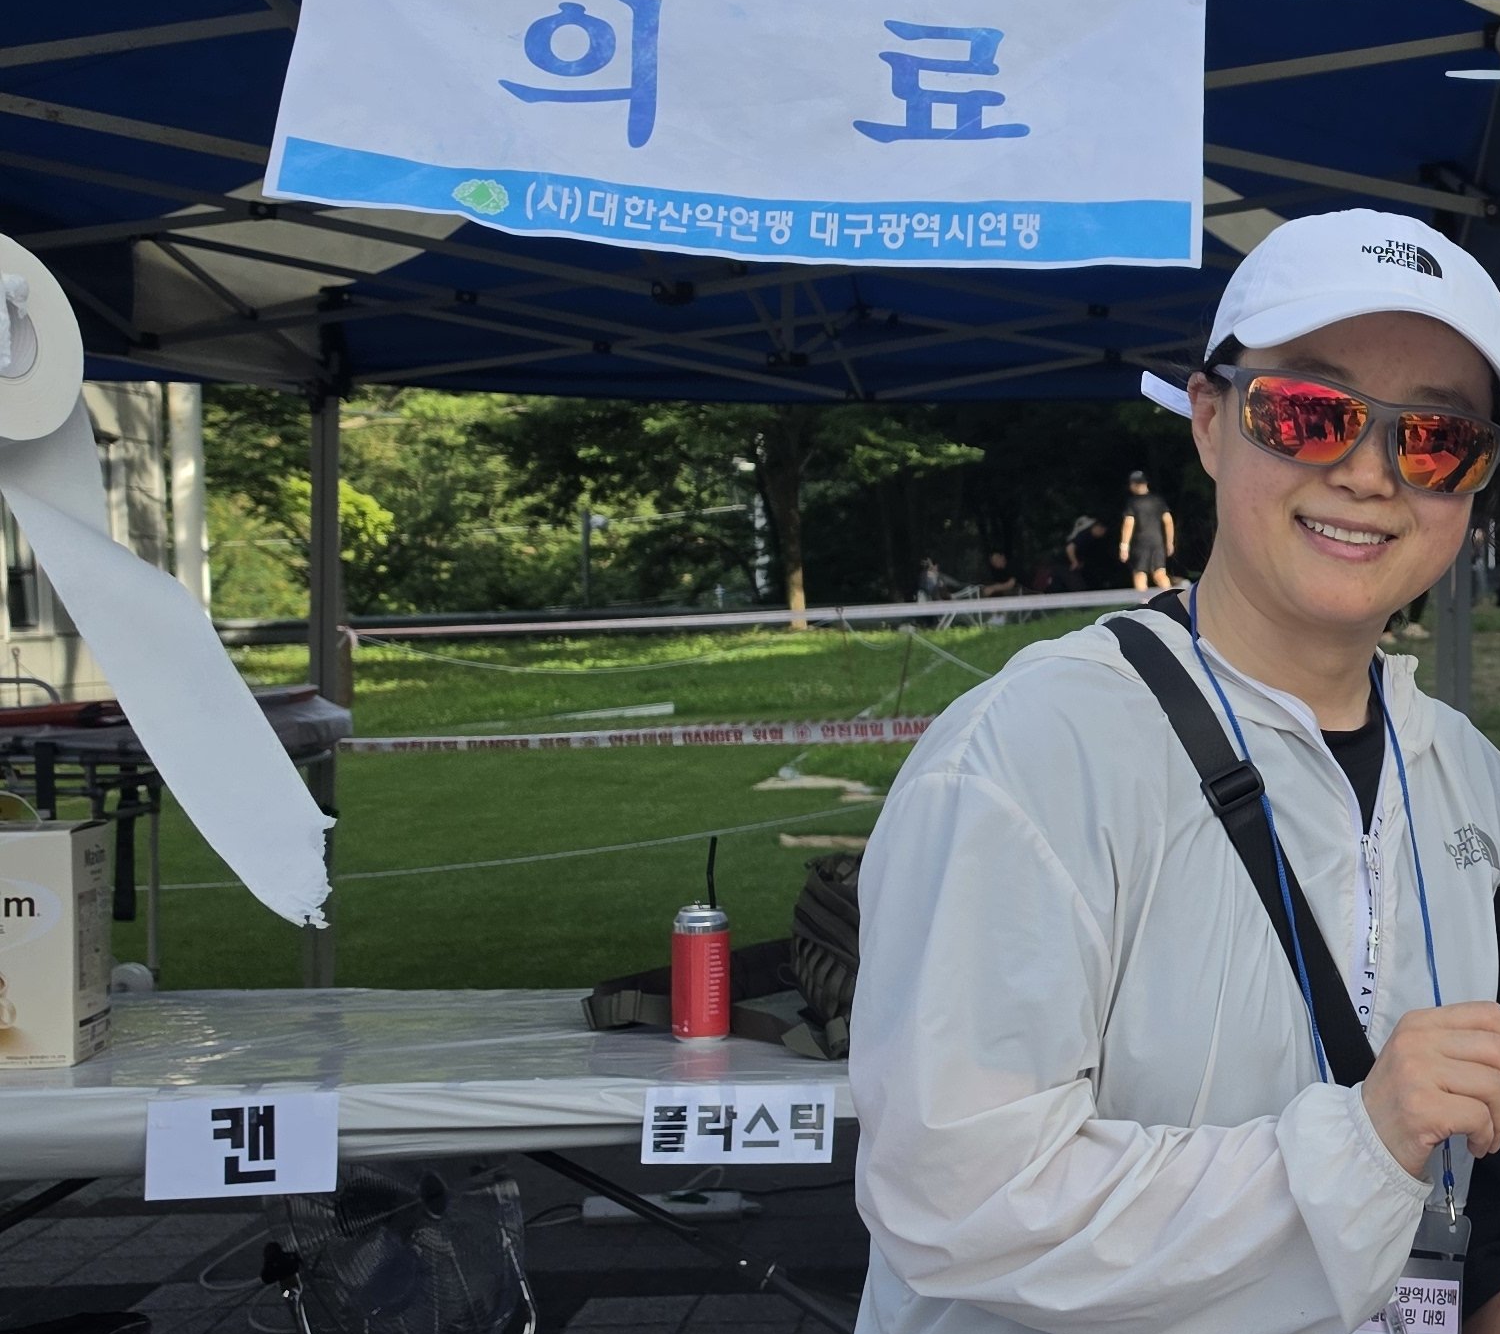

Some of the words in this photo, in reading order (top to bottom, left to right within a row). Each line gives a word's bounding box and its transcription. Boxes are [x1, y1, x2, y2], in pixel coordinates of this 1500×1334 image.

[524, 180, 795, 247] (사)대한산악연맹
[809, 207, 1042, 251] 대구광역시연맹
[1361, 245, 1416, 262] NORTH
[1385, 239, 1416, 253] THE
[1377, 255, 1416, 271] FACE
[681, 728, 744, 745] DANGER
[651, 1103, 825, 1153] 플라스틱
[210, 1104, 277, 1186] 캔
[1395, 1285, 1458, 1306] 광역시장배
[1422, 1309, 1446, 1327] 대회
